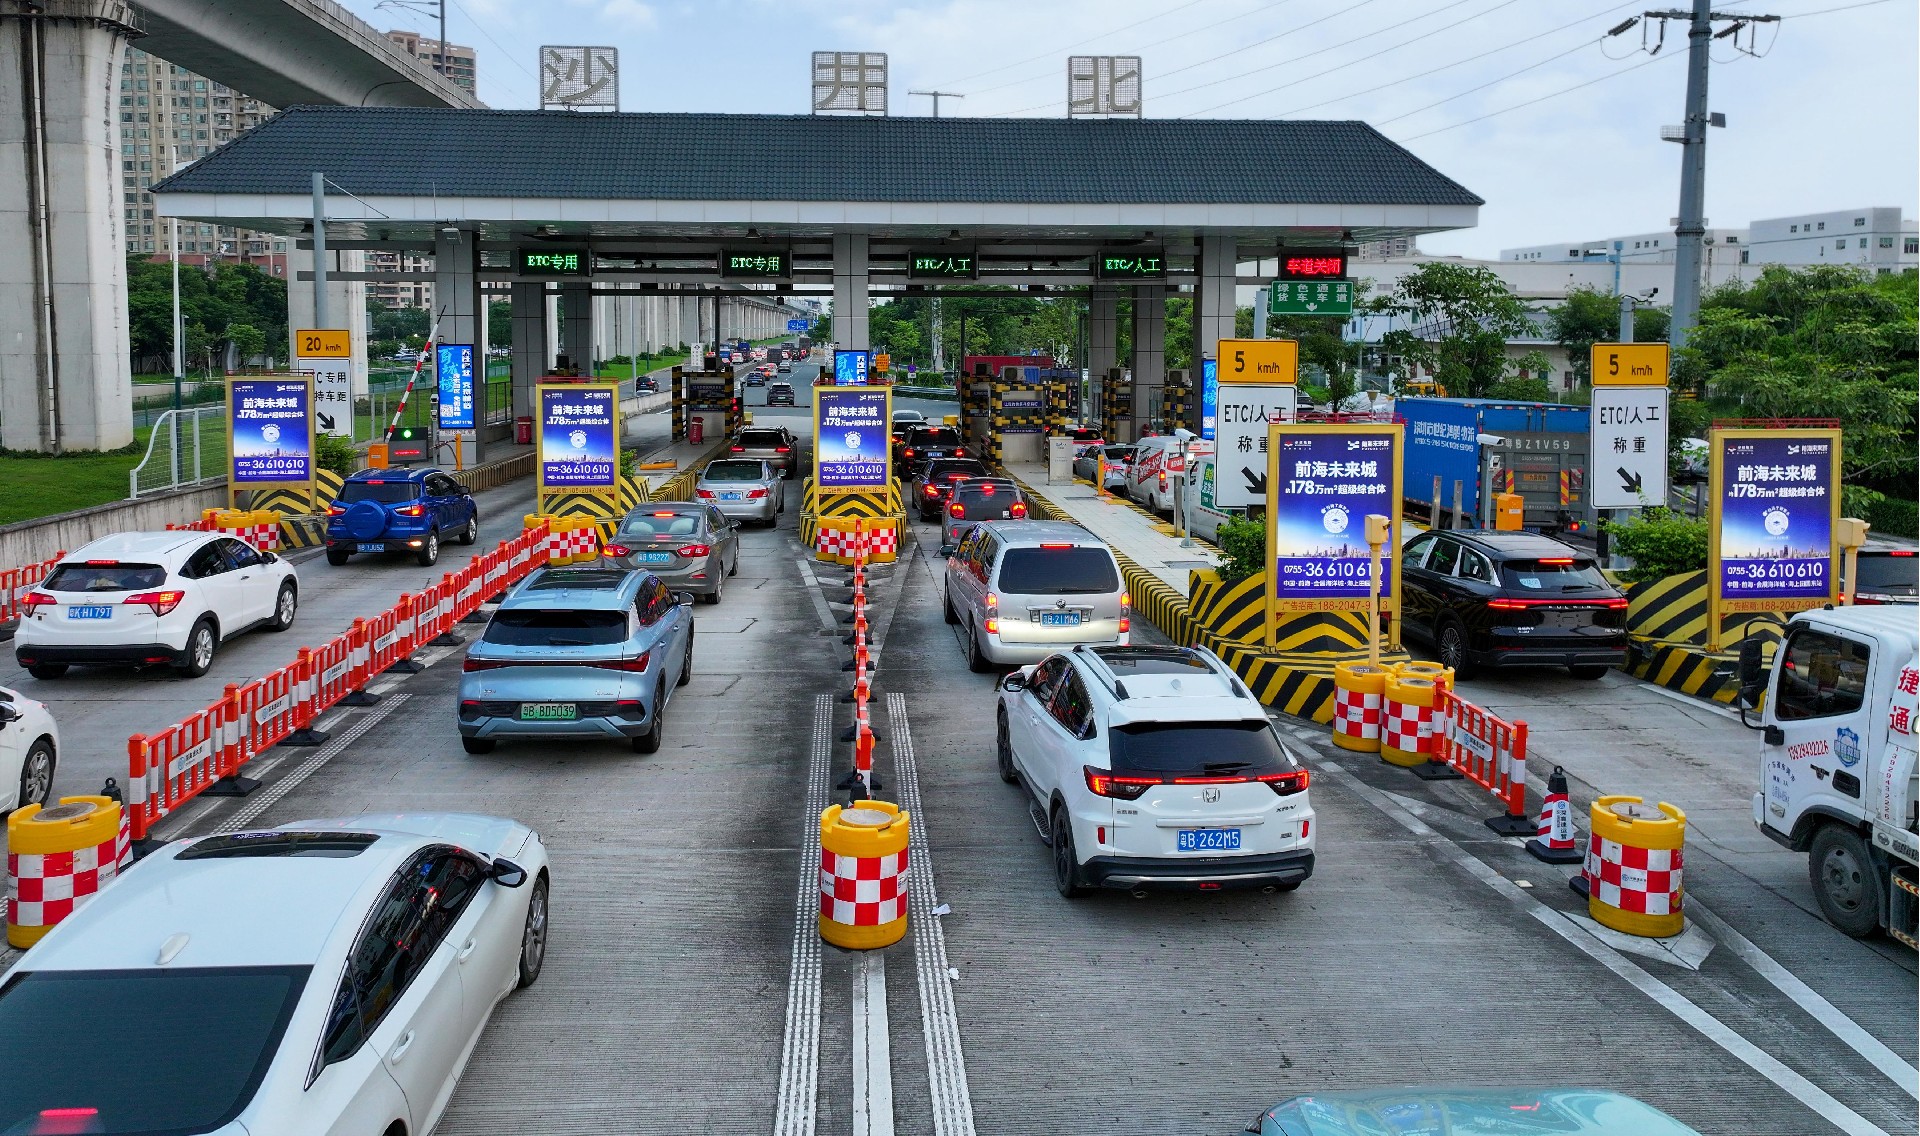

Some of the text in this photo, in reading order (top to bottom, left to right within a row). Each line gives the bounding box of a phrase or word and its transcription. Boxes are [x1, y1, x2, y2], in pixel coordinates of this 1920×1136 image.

[544, 46, 1140, 111] 沙 井 北
[527, 254, 578, 271] ETC专用
[730, 256, 780, 272] ETC专用
[915, 257, 971, 273] ETC/人工
[1105, 257, 1161, 273] ETC/人工
[1286, 258, 1342, 275] 车道关闭
[1277, 284, 1347, 293] 绿色通道
[1277, 293, 1347, 302] 货车车道
[305, 336, 342, 352] 20 km/h
[1235, 351, 1280, 374] 5 km/h
[1609, 353, 1653, 376] 5 km/h
[242, 397, 298, 408] 前海未来城
[314, 391, 347, 402] 持车距
[552, 404, 604, 415] 前海未来城
[828, 406, 878, 416] 前海未来城
[1224, 404, 1287, 423] ETC/人工
[1600, 406, 1659, 425] ETC/人工
[1613, 436, 1646, 454] 称重
[266, 459, 284, 469] 610
[285, 459, 304, 469] 610
[573, 465, 591, 474] 610
[592, 464, 609, 474] 610
[848, 465, 865, 474] 610
[866, 464, 882, 473] 610
[1295, 461, 1378, 478] 前海未来城
[1737, 464, 1817, 482] 前海未来城
[1284, 562, 1324, 577] 0755-36
[1327, 562, 1354, 577] 610
[1727, 562, 1822, 578] 0755-36 610 610
